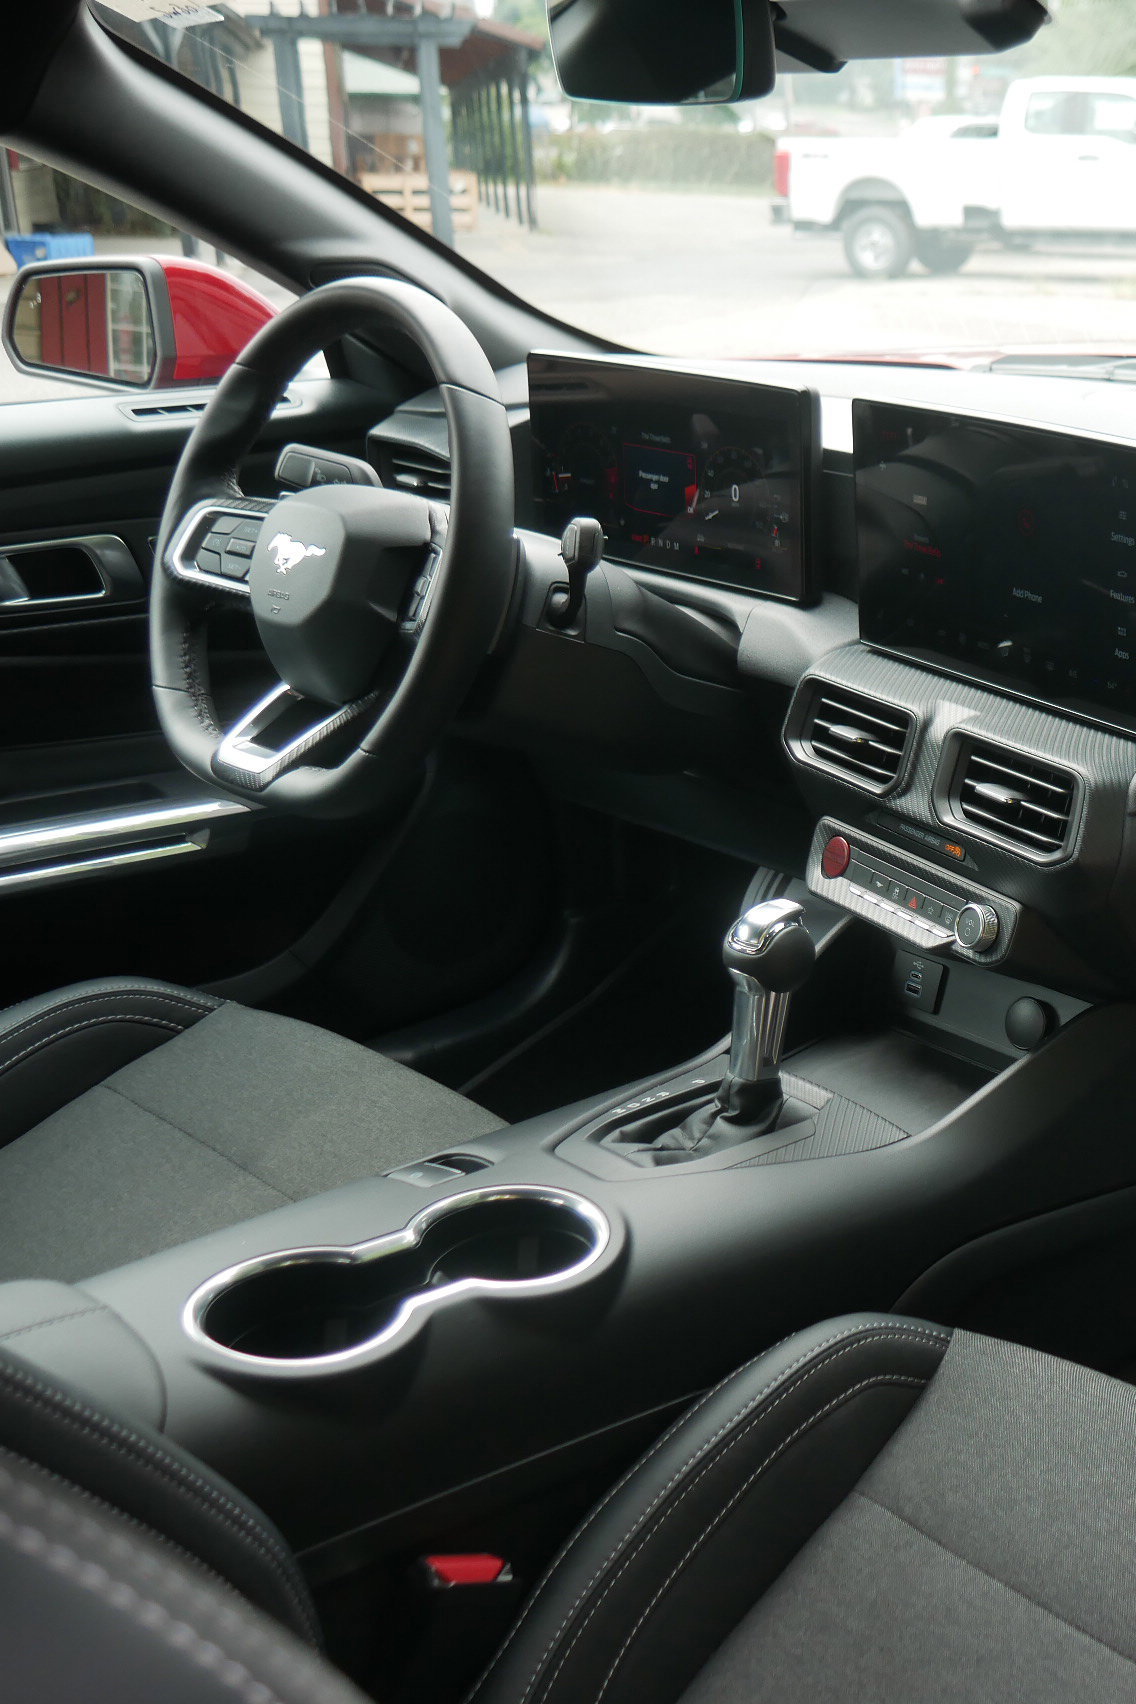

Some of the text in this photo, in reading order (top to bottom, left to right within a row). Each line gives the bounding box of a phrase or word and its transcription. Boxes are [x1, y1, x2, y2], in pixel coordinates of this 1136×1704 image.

[731, 484, 740, 502] 0
[1110, 531, 1135, 547] Settings
[1012, 586, 1043, 604] Add Phone
[1110, 589, 1135, 604] Features
[1114, 648, 1130, 661] Apps
